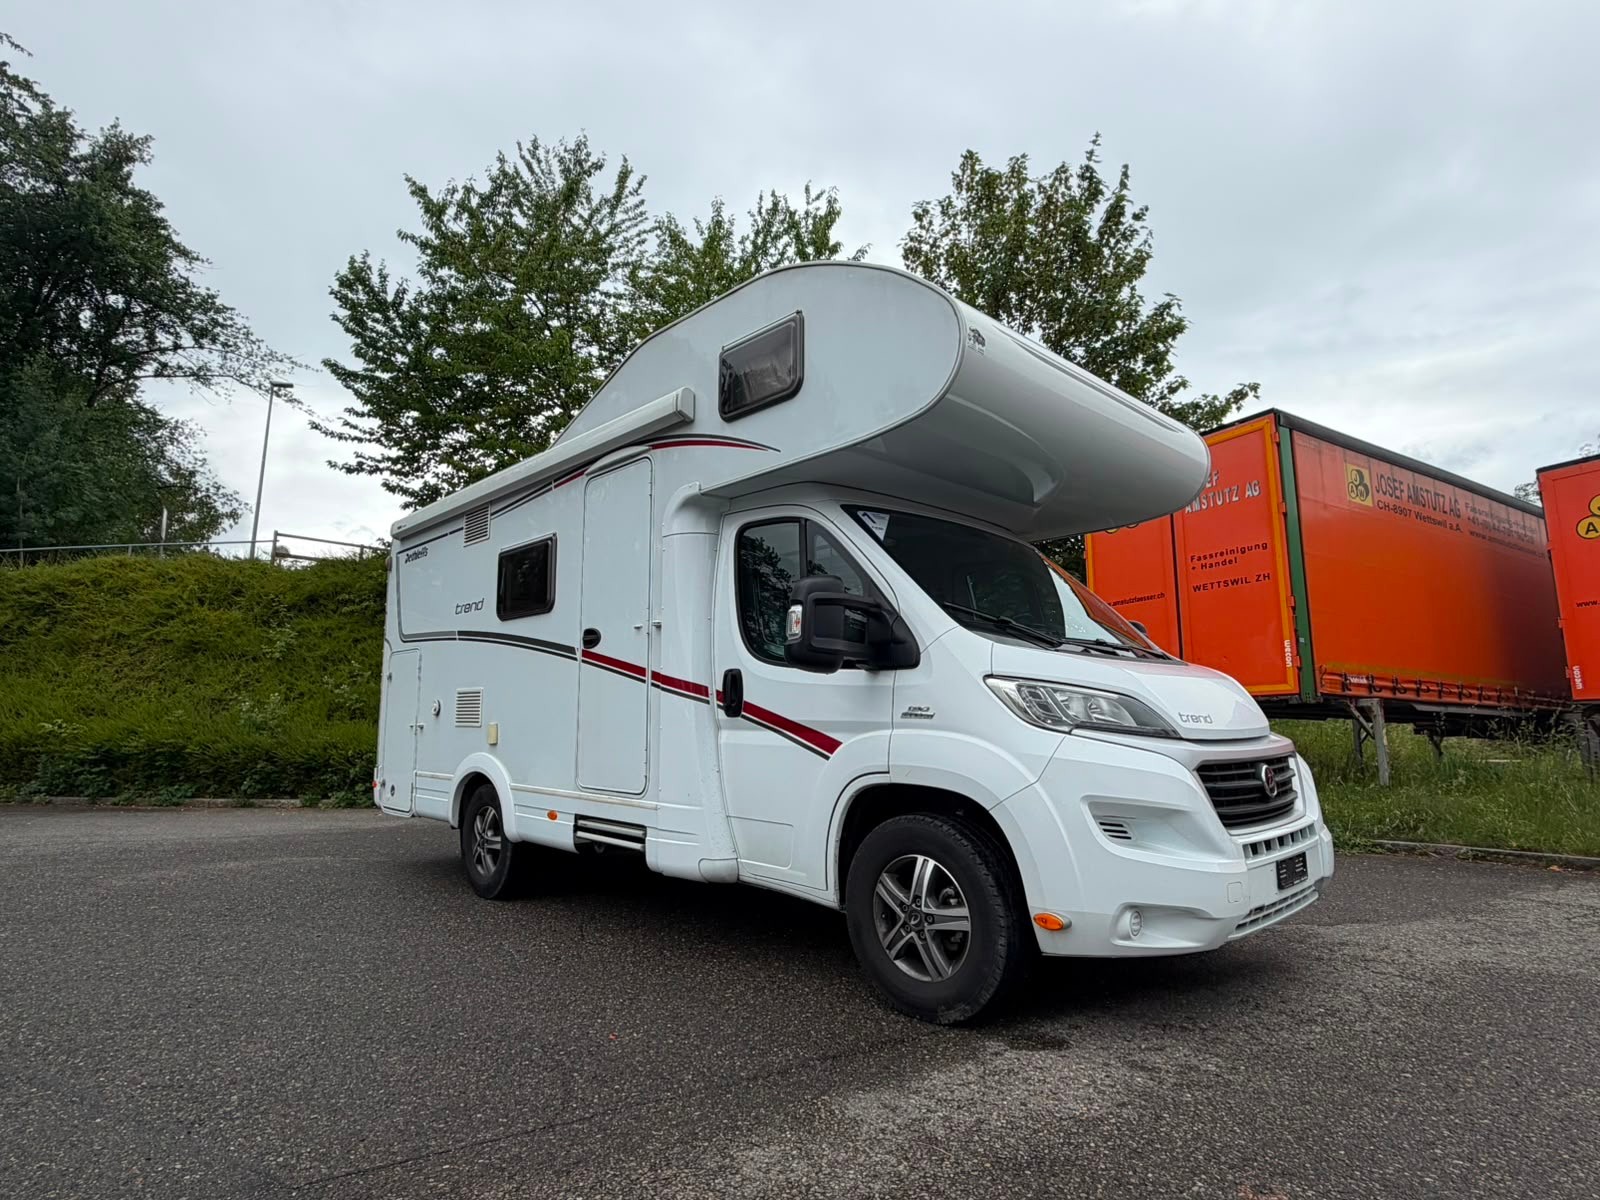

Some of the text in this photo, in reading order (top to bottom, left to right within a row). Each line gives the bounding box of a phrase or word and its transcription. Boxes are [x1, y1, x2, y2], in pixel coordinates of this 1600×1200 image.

[1185, 480, 1261, 514] AMSTUTZ AG
[1375, 473, 1404, 500] JOSEF
[1407, 483, 1448, 514] AMSTUTZ
[1449, 496, 1461, 519] AG
[1377, 500, 1412, 517] CH-8907
[1585, 522, 1599, 535] A
[1190, 542, 1268, 563] Fassreinigung
[1200, 557, 1238, 571] Handel
[1192, 573, 1271, 593] WETTSWIL ZH
[455, 597, 485, 615] trend
[1284, 640, 1293, 668] wecon
[1572, 665, 1583, 690] wecon
[1178, 711, 1213, 724] trend
